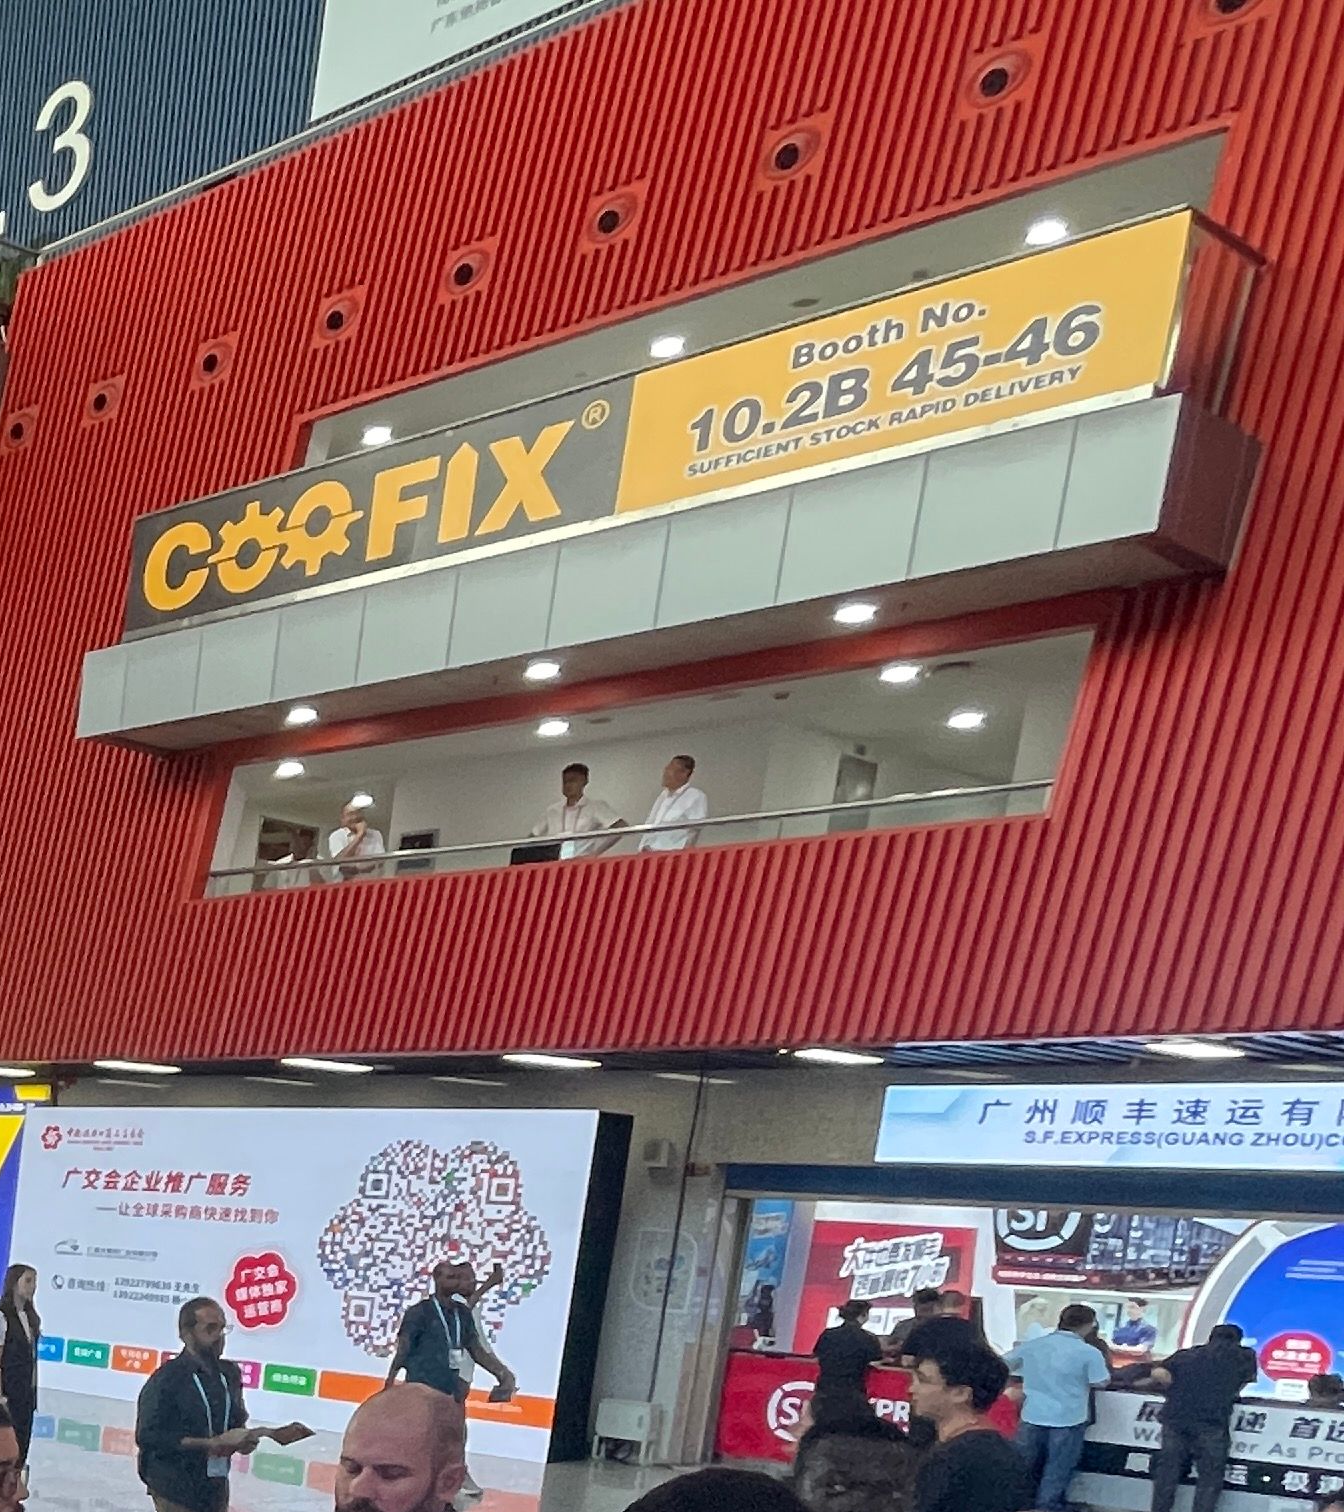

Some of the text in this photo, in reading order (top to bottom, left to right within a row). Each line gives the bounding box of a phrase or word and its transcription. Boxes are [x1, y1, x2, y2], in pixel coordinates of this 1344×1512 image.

[790, 300, 987, 370] Booth No.
[689, 303, 1102, 453] 10.2B 45-46
[686, 364, 1083, 478] SUFFICIENT STOCK RAPID DELIVERY
[977, 1098, 1344, 1126] 广州顺丰速运有
[1024, 1130, 1344, 1151] S.F.EXPRESS(GUANG ZHOU)C
[61, 1167, 252, 1198] 广交会企业推广服务
